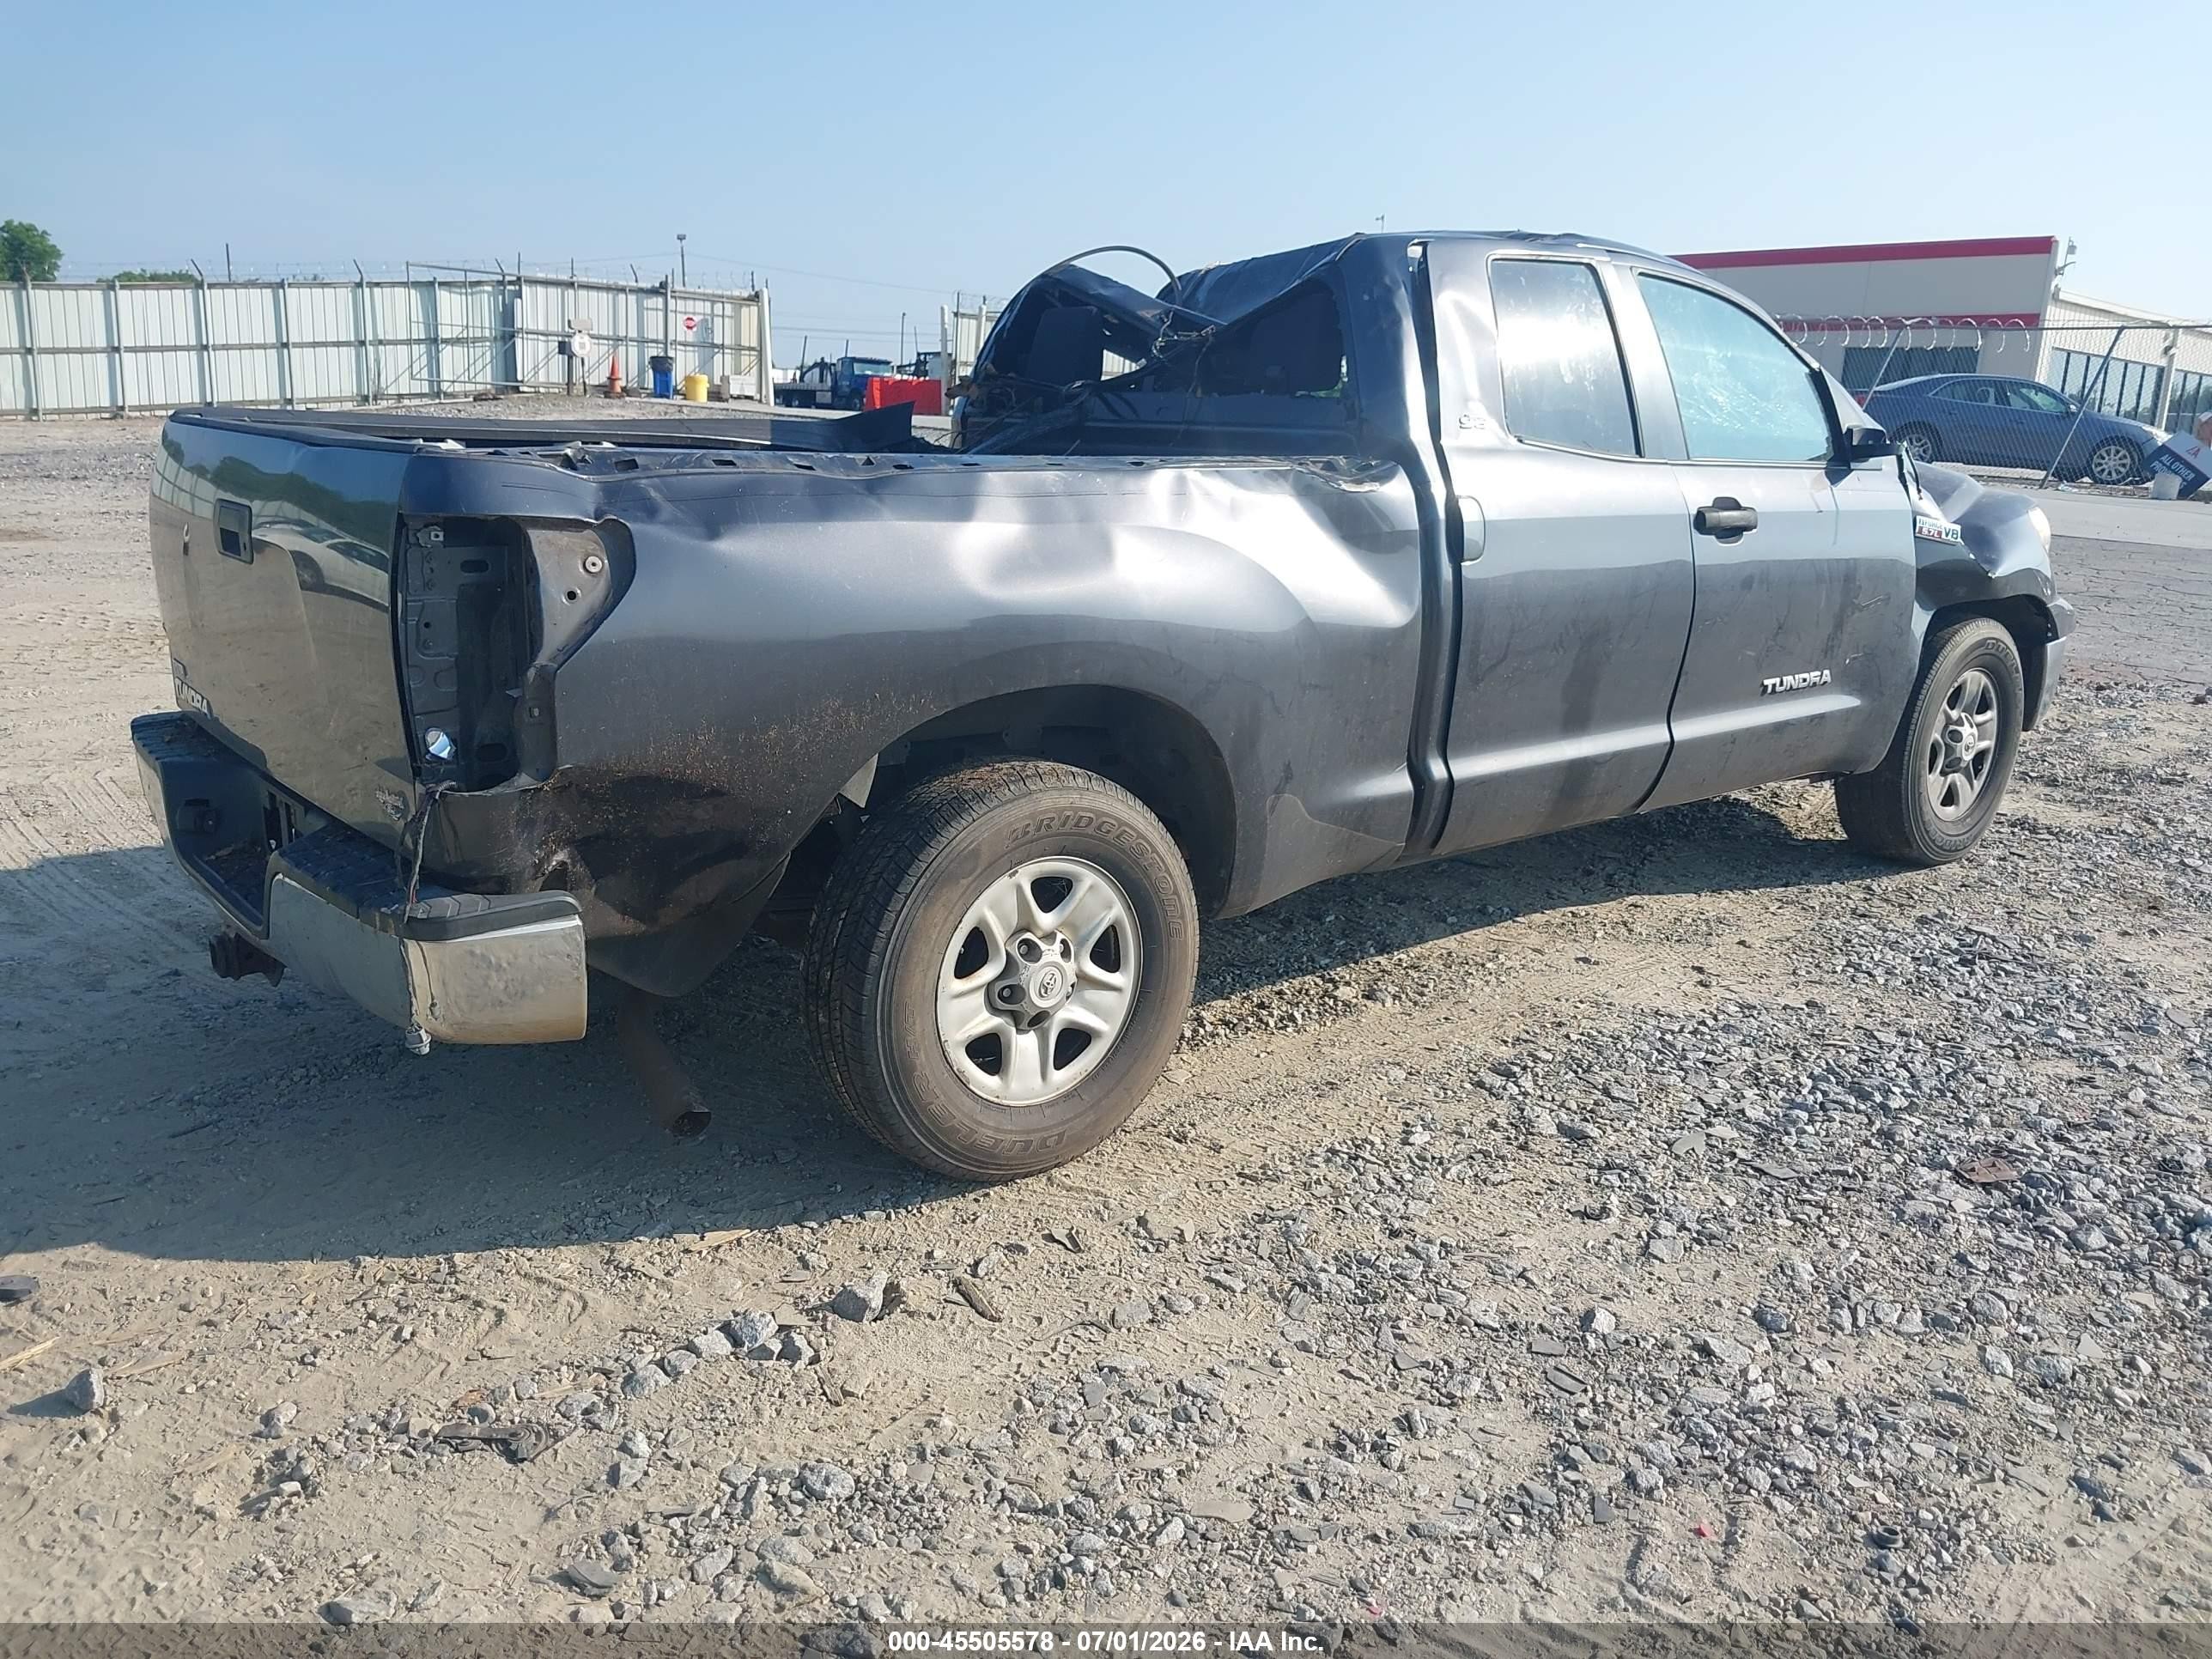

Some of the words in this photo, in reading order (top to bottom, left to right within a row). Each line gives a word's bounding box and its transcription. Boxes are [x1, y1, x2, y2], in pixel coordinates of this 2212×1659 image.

[2160, 454, 2173, 466] ALL
[2172, 462, 2196, 481] OTHER
[1943, 526, 1959, 540] V8
[1762, 669, 1832, 694] TUNDRA
[1004, 811, 1184, 942] BRIDGESTONE
[910, 1071, 1068, 1158] DUELER
